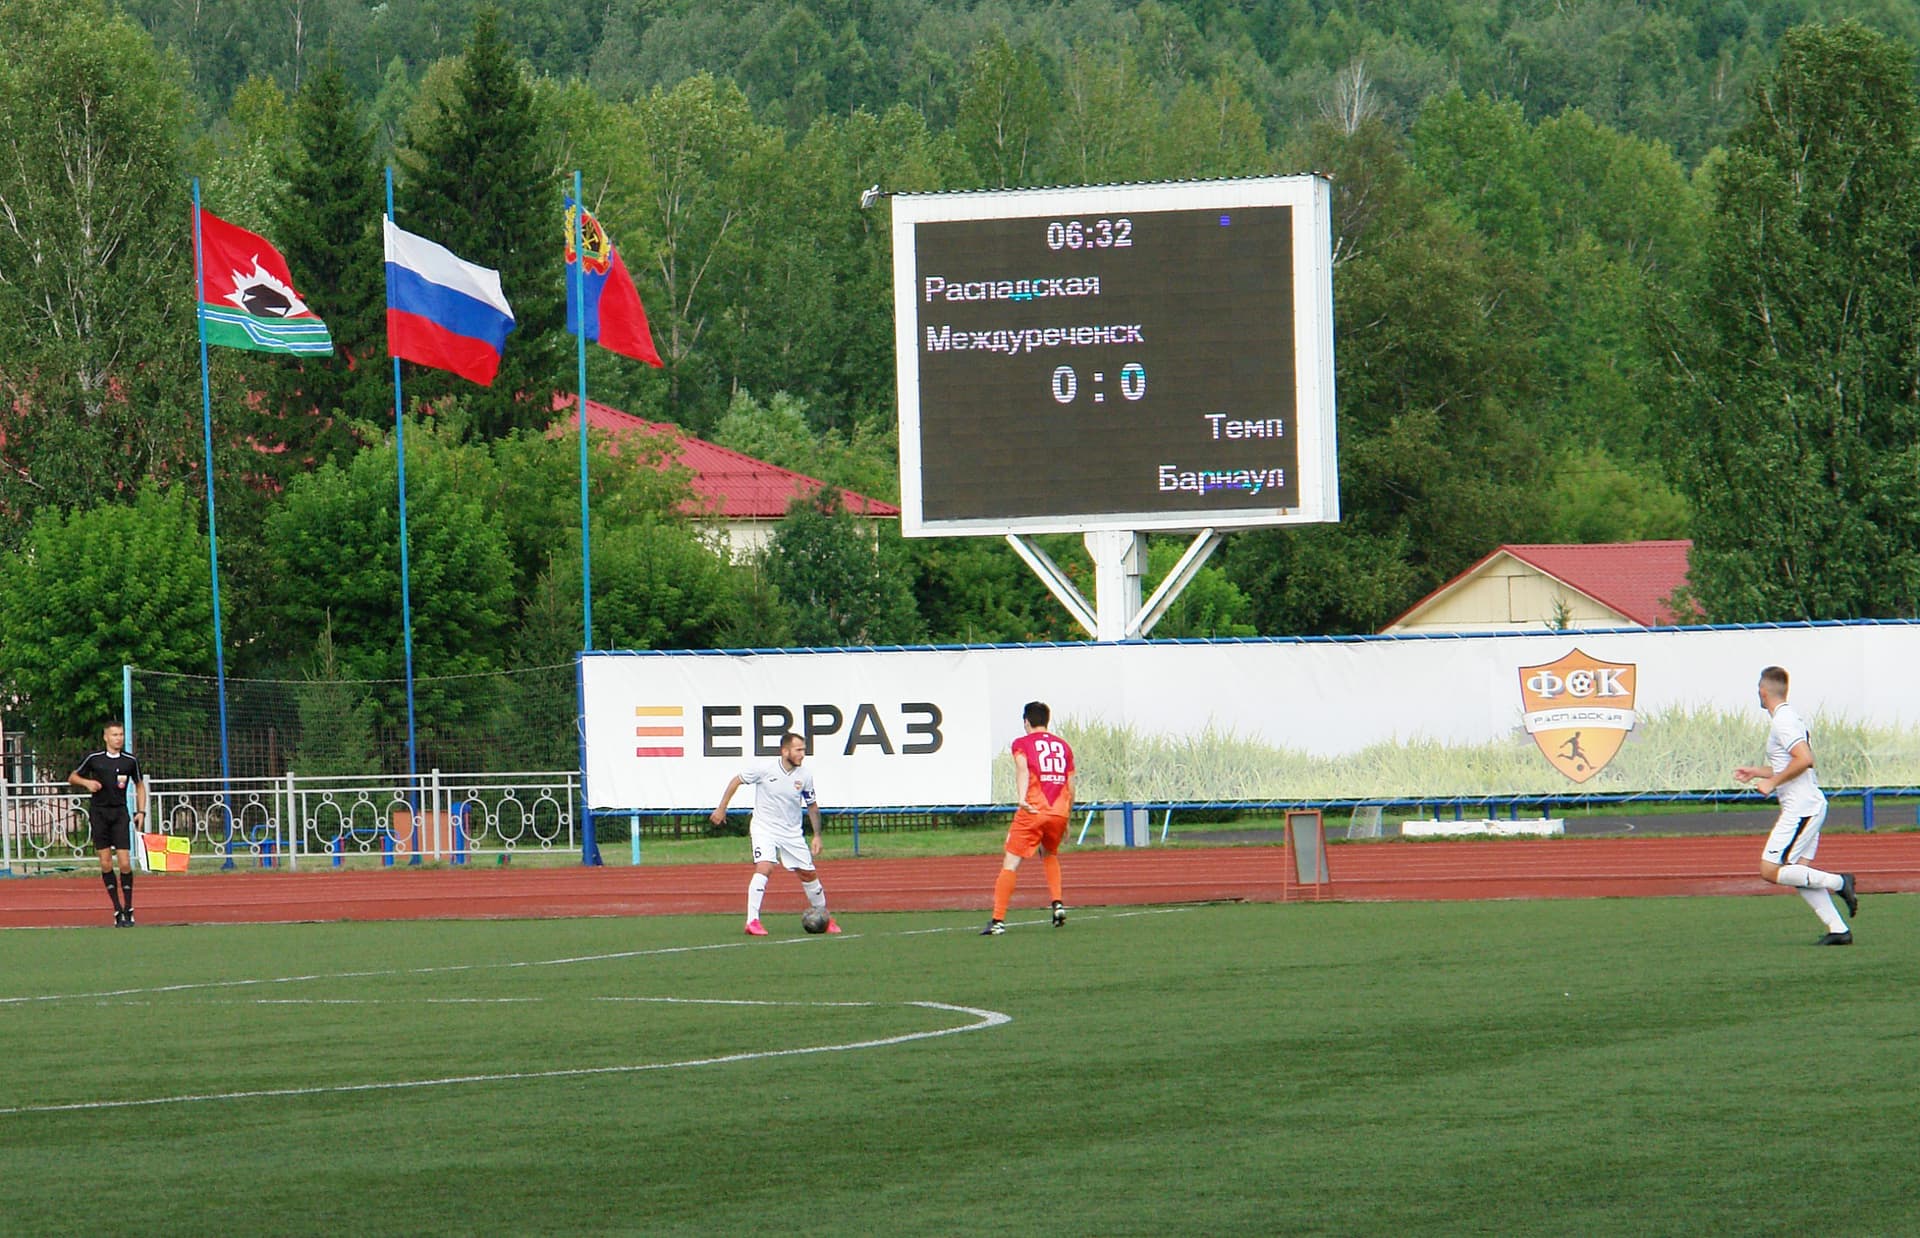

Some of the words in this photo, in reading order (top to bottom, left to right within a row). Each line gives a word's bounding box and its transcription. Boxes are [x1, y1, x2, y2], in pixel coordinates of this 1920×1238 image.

[1047, 218, 1133, 249] 06:32
[925, 275, 1100, 301] Распадская
[927, 323, 1144, 354] Междуреченск
[1052, 366, 1077, 403] 0
[1121, 363, 1146, 400] 0
[1204, 413, 1284, 439] Темп
[1159, 464, 1285, 495] Барнаул
[1527, 668, 1631, 698] ФСК
[702, 702, 943, 757] ЕВРАЗ
[1035, 740, 1067, 773] 23
